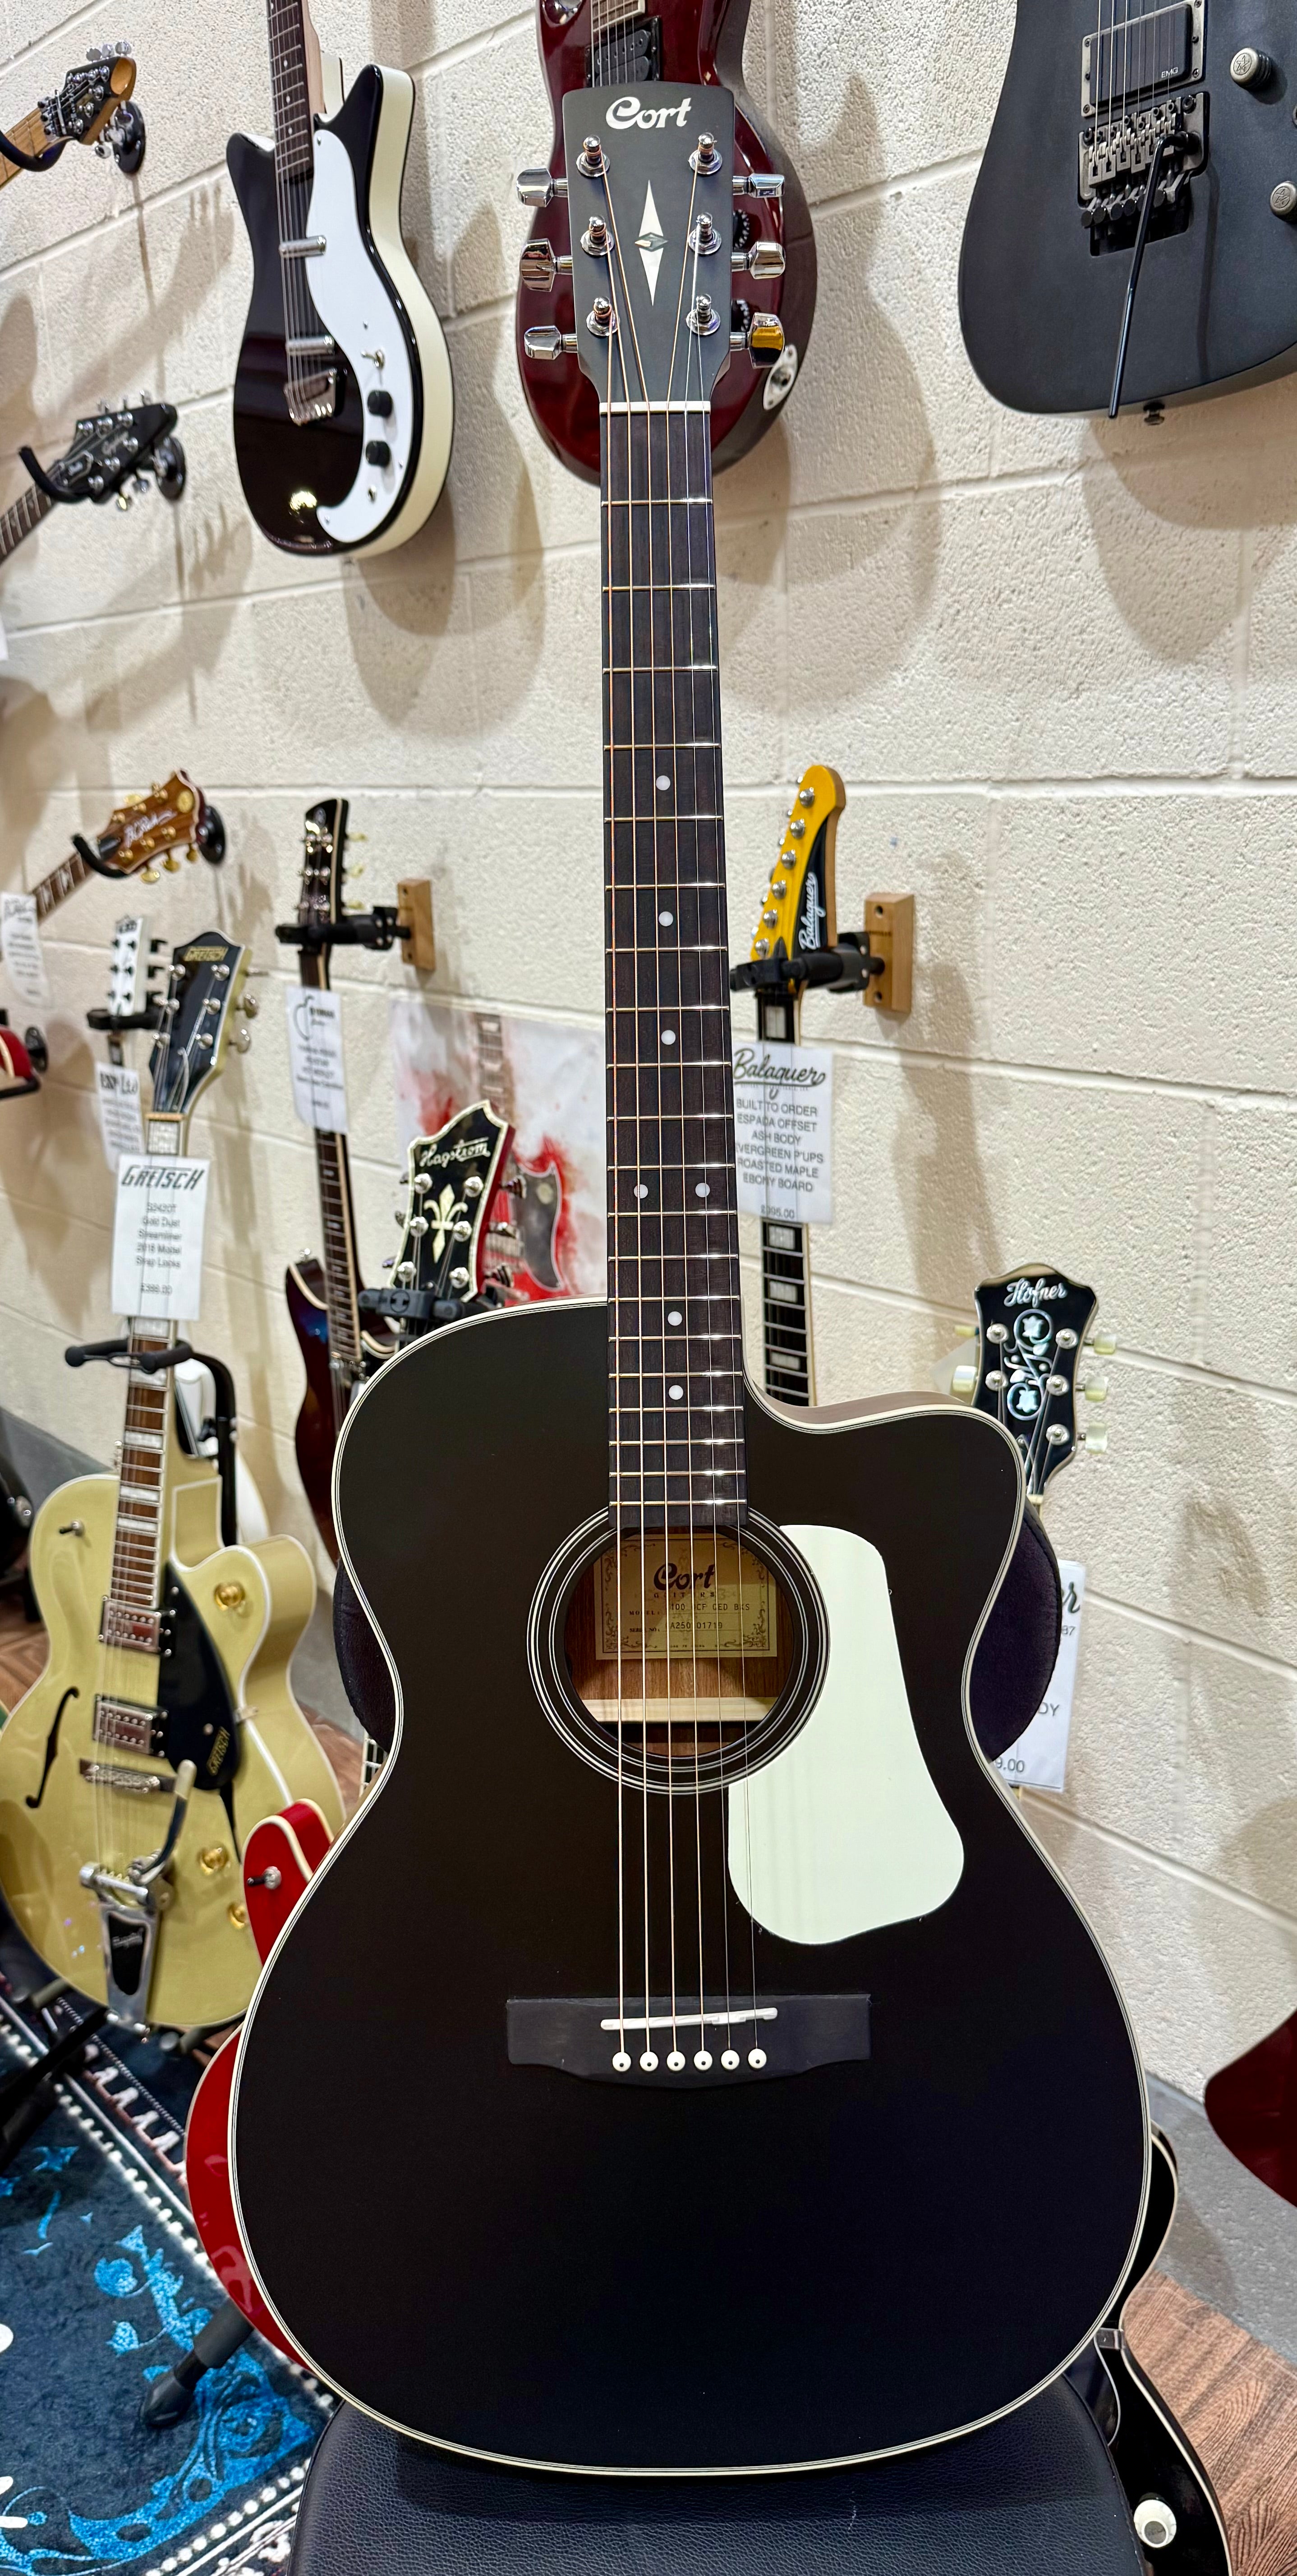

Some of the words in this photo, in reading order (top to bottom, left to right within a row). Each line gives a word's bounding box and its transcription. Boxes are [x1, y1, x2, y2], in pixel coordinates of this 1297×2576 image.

[1161, 67, 1178, 78] EMG
[606, 96, 692, 129] Cort
[798, 871, 826, 950] Balaguer
[733, 1048, 826, 1100] Balaguer
[736, 1098, 763, 1112] BUILT
[766, 1101, 779, 1113] TO
[781, 1103, 818, 1117] ORDER
[737, 1113, 776, 1127] ESPADA
[777, 1119, 818, 1132] OFFSET
[751, 1131, 771, 1143] ASH
[773, 1133, 801, 1145] BODY
[794, 1150, 824, 1164] P'UPS
[121, 1164, 205, 1191] GRETSCH
[737, 1158, 782, 1173] ROASTED
[784, 1164, 819, 1178] MAPLE
[743, 1173, 776, 1187] EBONY
[777, 1178, 814, 1193] BOARD
[653, 1562, 715, 1591] Cort
